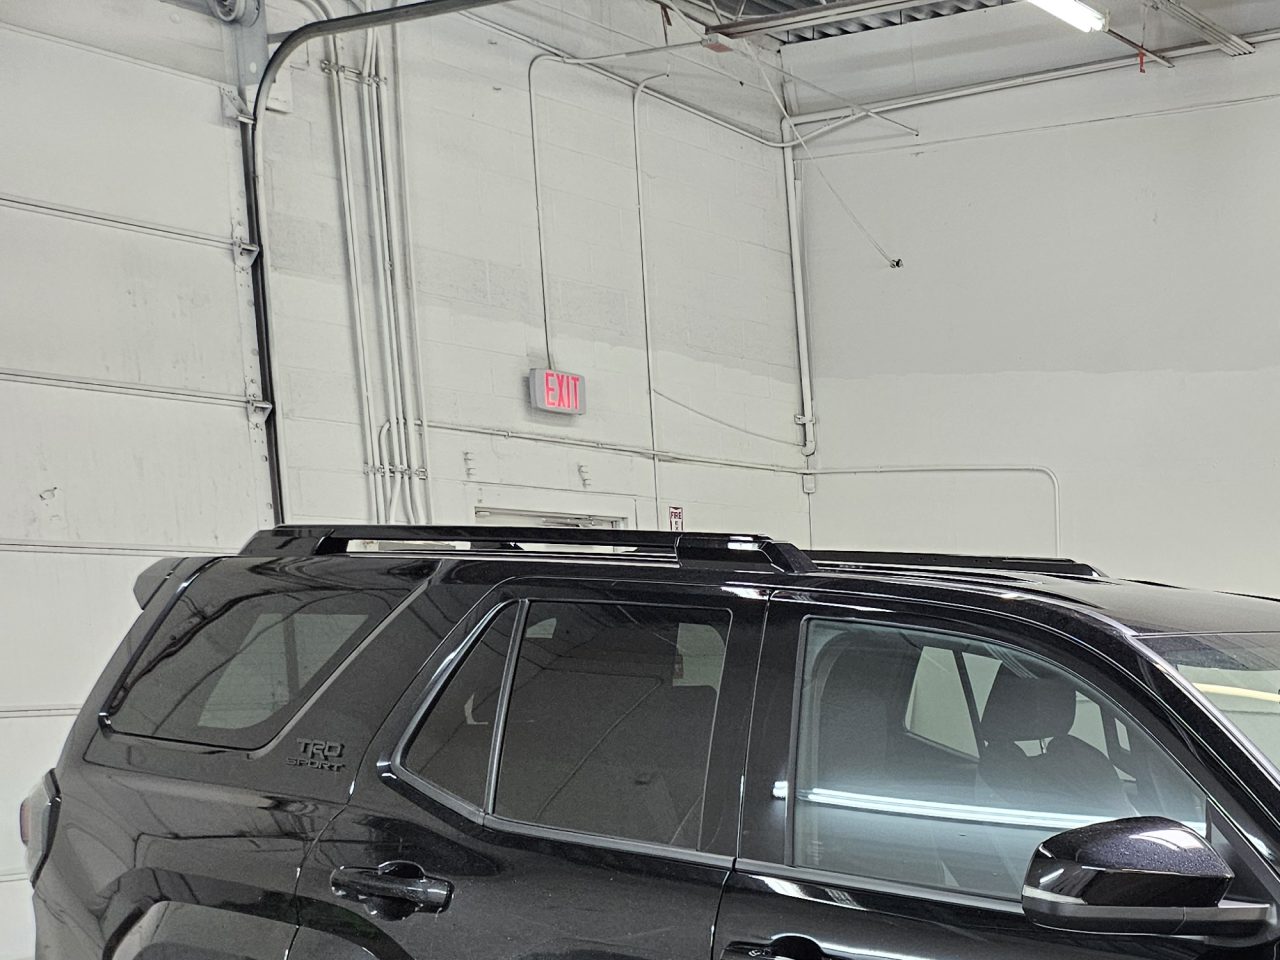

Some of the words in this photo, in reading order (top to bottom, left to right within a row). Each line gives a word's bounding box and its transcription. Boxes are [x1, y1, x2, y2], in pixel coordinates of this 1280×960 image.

[545, 372, 580, 410] EXIT
[670, 511, 682, 520] FIRE
[297, 738, 345, 761] TRD
[286, 757, 346, 773] SPORT
